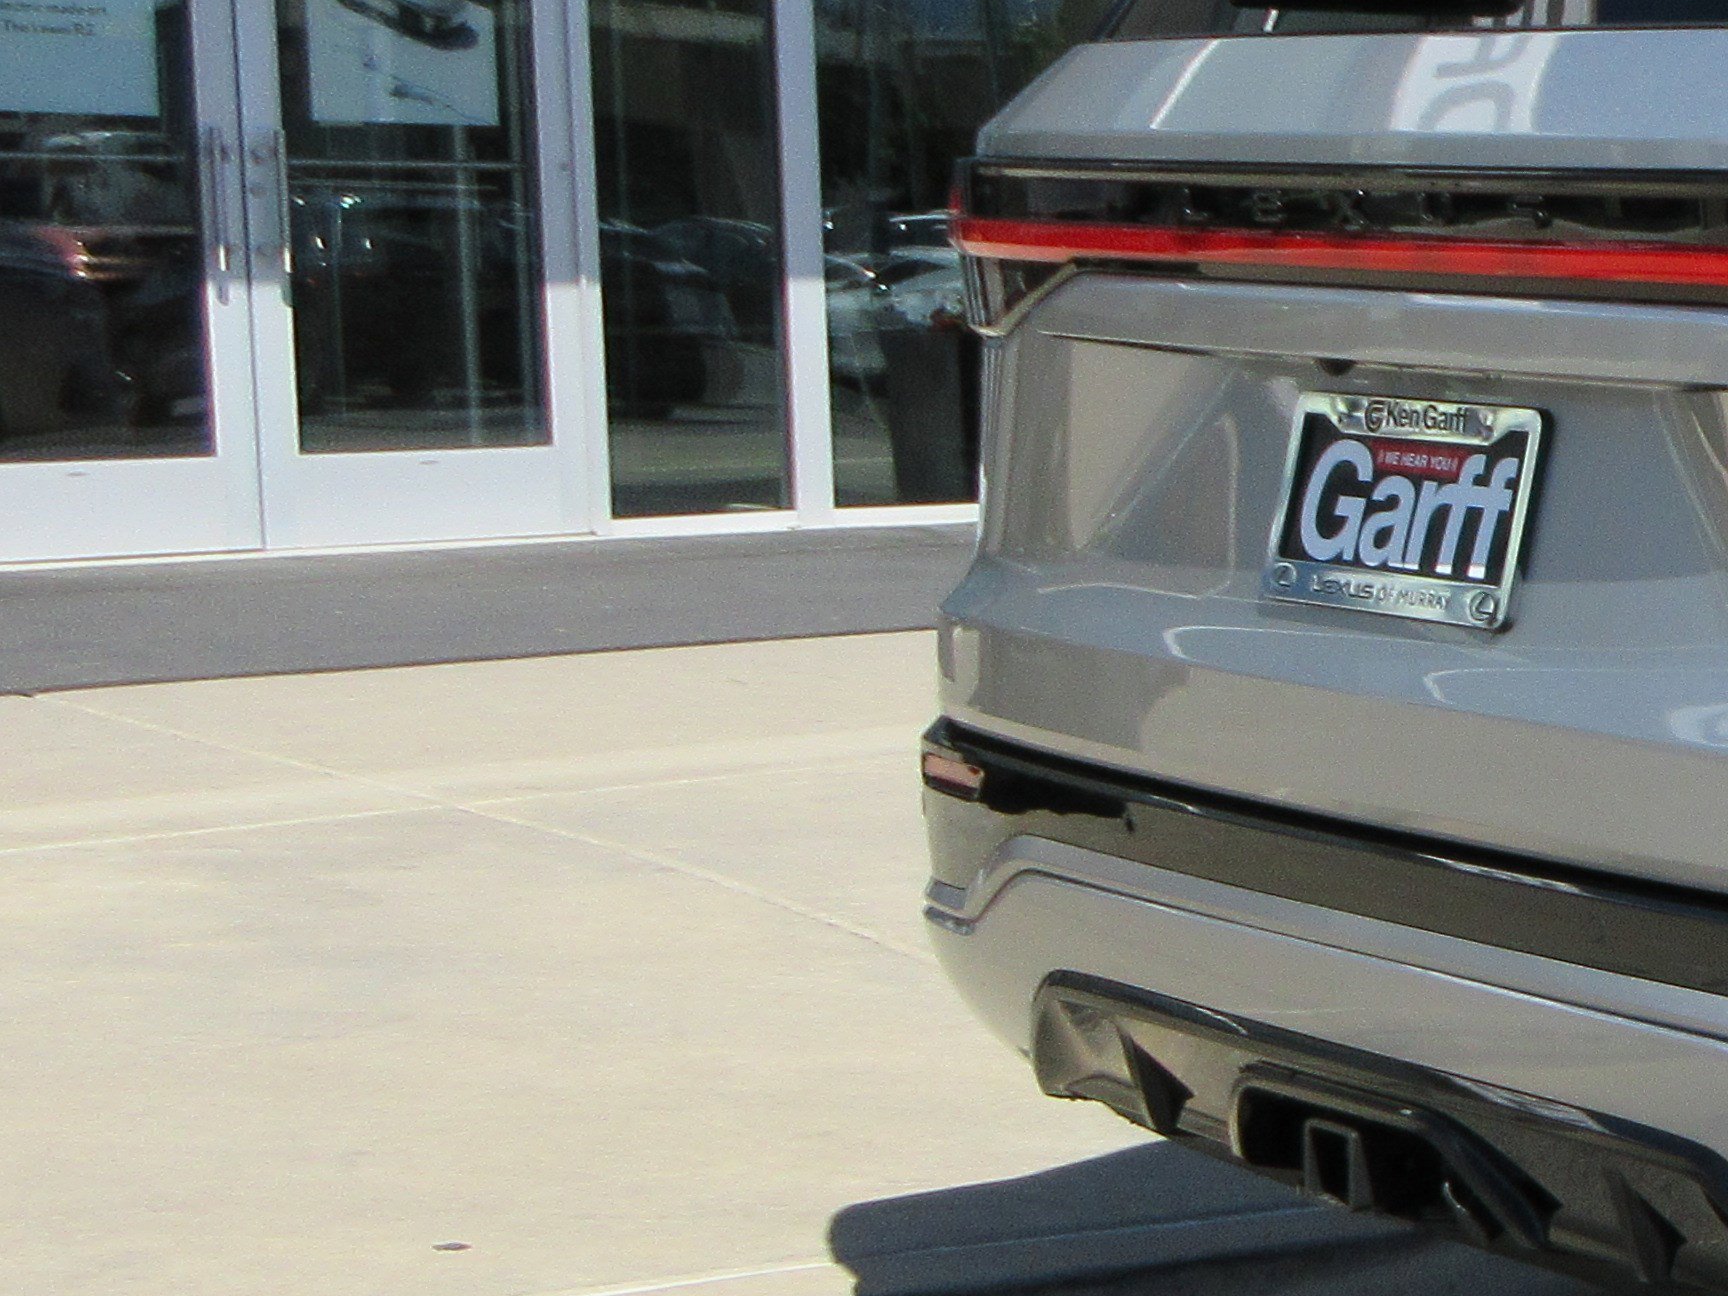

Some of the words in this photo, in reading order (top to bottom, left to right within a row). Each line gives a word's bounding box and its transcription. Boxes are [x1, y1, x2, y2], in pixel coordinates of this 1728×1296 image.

[1386, 400, 1421, 428] Ken
[1423, 404, 1468, 433] Garff
[1300, 438, 1520, 581] Garff
[1311, 574, 1375, 601] LEXUS
[1376, 582, 1395, 606] OF
[1397, 588, 1452, 611] MURRAY
